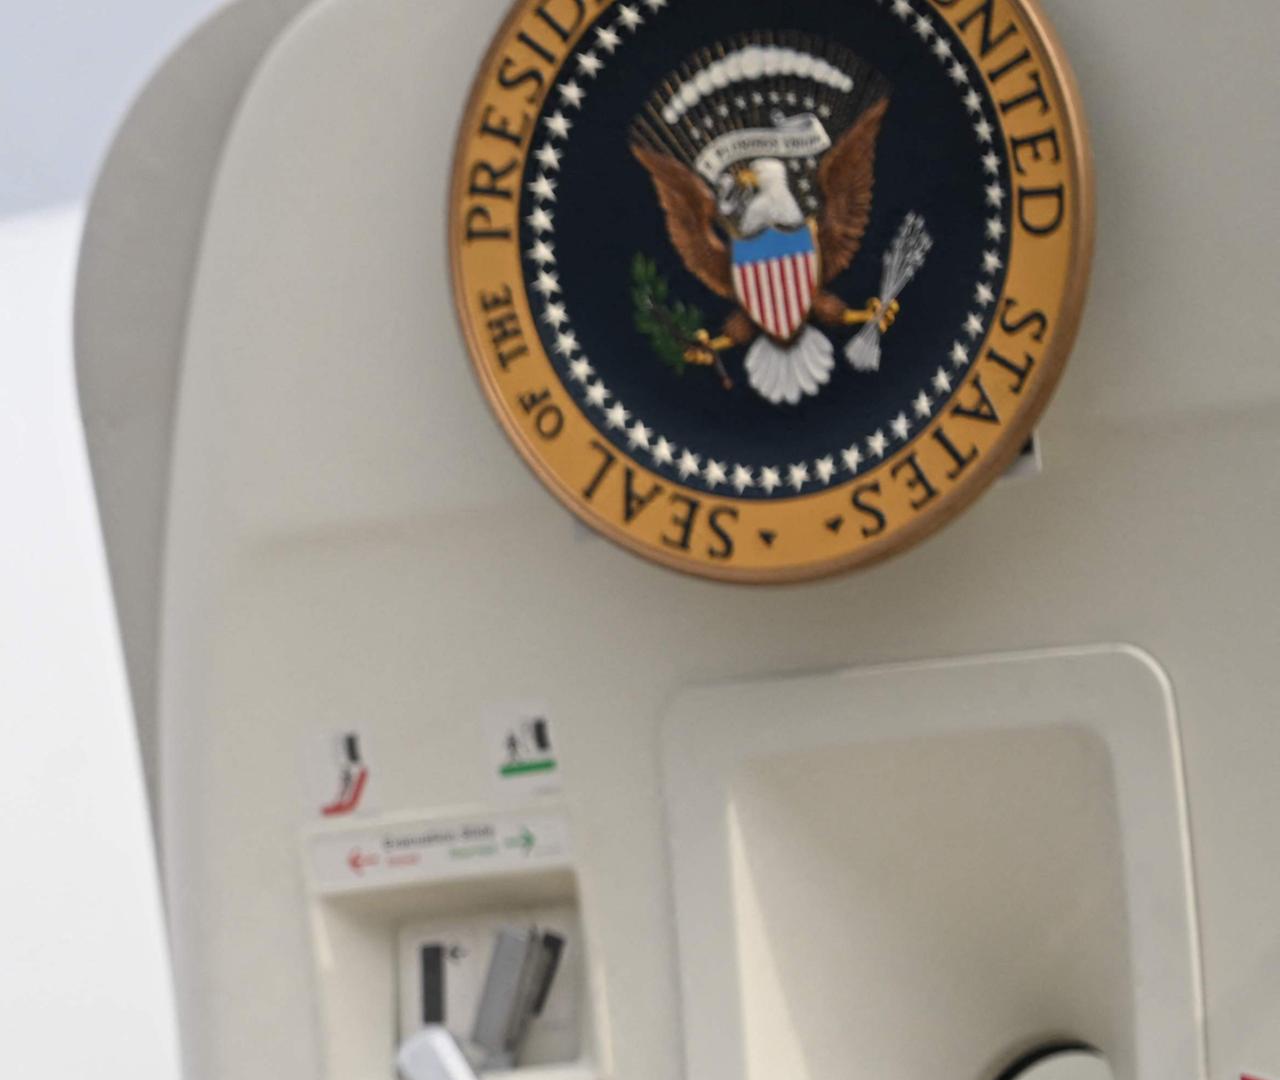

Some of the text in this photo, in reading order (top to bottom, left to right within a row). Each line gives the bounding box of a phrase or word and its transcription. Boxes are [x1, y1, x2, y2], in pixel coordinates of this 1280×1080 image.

[465, 0, 739, 559] SEAL OF THE PRESID
[850, 0, 1065, 538] NITED STATES
